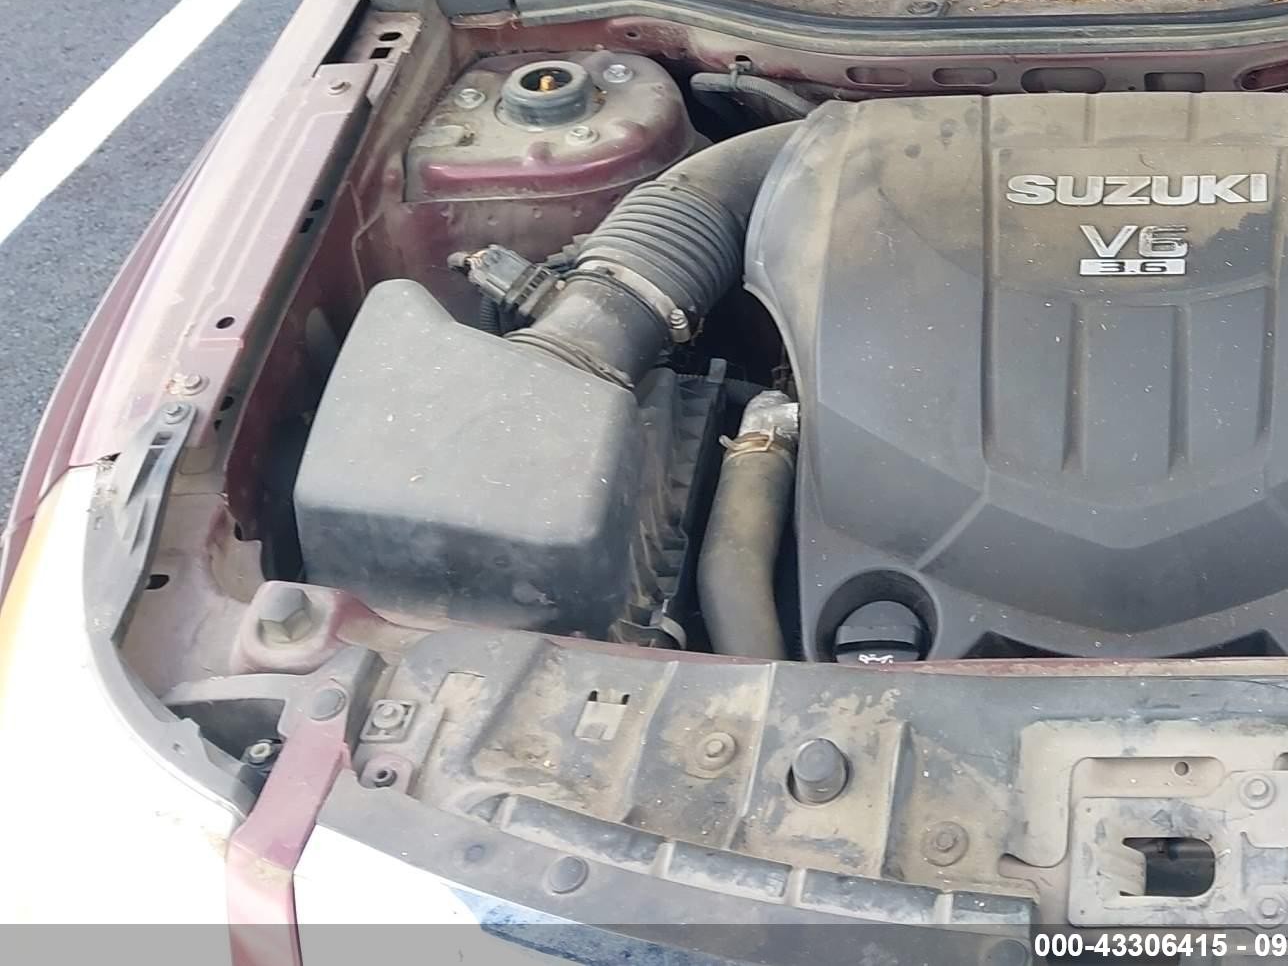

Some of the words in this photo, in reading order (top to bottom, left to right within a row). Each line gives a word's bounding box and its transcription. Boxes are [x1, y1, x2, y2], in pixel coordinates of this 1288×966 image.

[1005, 173, 1268, 206] SUZUKI
[1079, 224, 1189, 258] V6
[1096, 259, 1168, 274] 3.6
